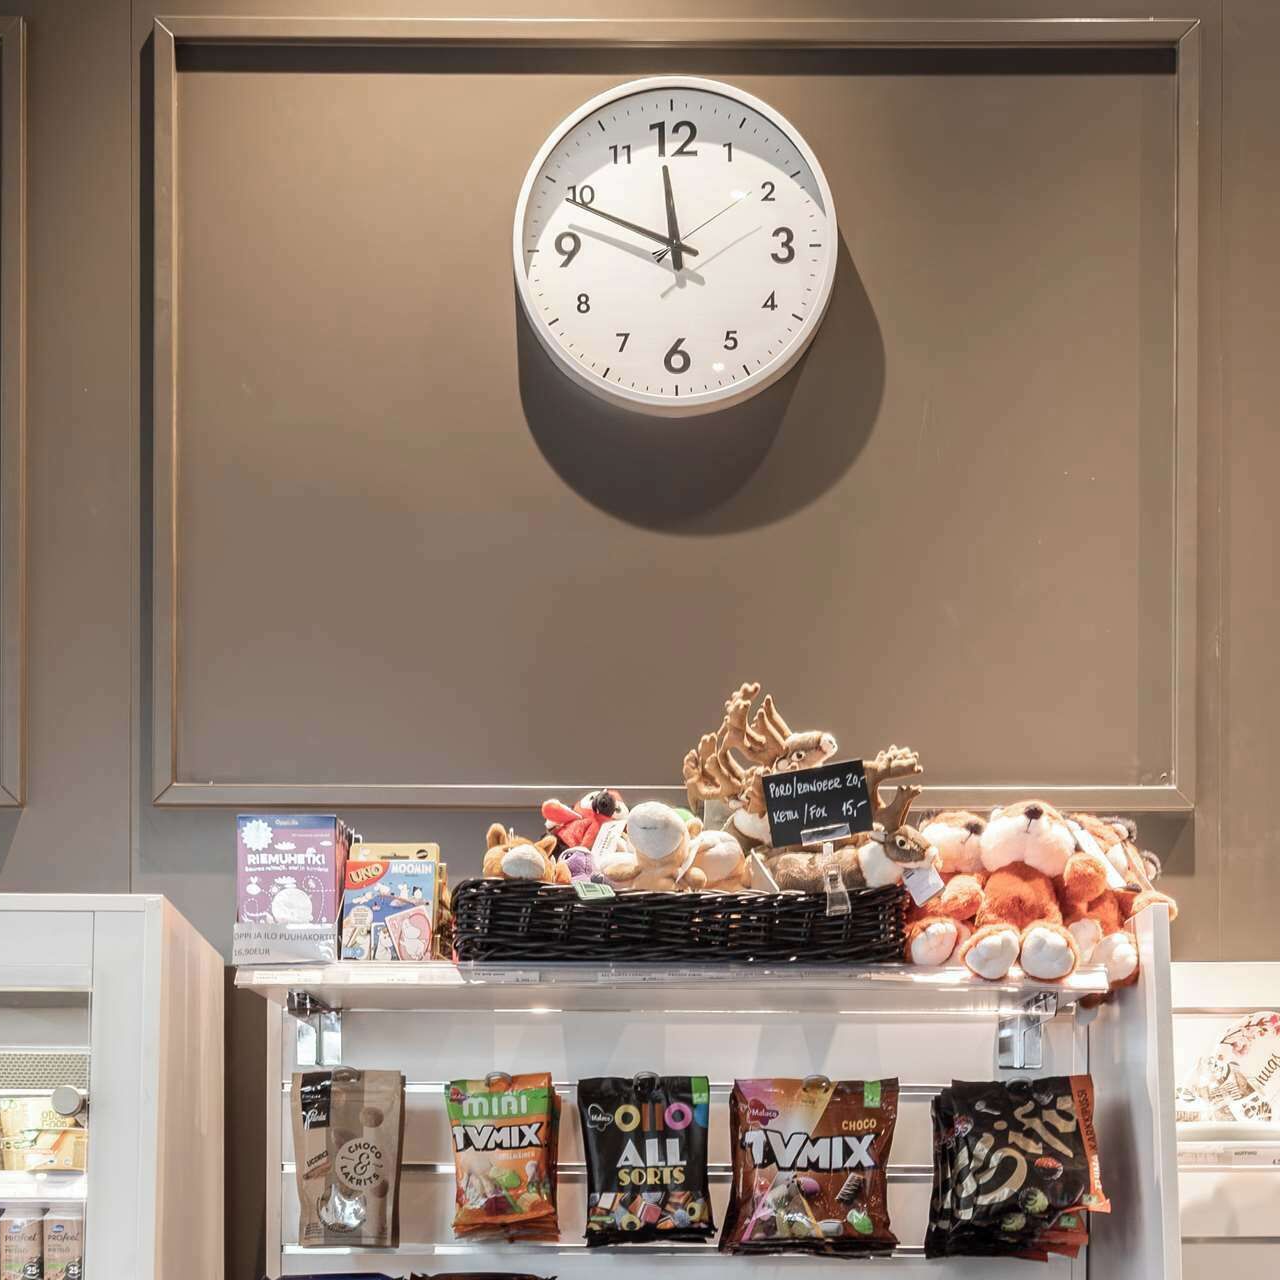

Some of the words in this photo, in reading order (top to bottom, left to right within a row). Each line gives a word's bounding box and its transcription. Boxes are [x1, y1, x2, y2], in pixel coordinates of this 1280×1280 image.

[649, 120, 698, 157] 12
[609, 144, 631, 164] 11
[723, 143, 733, 162] 1
[567, 185, 595, 206] 10
[761, 181, 776, 201] 2
[554, 231, 582, 268] 9
[770, 227, 795, 264] 3
[576, 293, 591, 313] 8
[761, 291, 778, 311] 4
[615, 332, 631, 352] 7
[723, 331, 738, 351] 5
[663, 338, 691, 374] 6
[349, 863, 384, 883] UNO
[391, 863, 432, 874] MOOMIN
[462, 1095, 528, 1117] mini
[751, 1109, 778, 1118] Malaco
[842, 1119, 877, 1131] CHOCO
[348, 1142, 382, 1159] CHOCO
[616, 1137, 687, 1168] ALL
[340, 1165, 380, 1185] LAKRITS
[618, 1167, 686, 1186] SORTS
